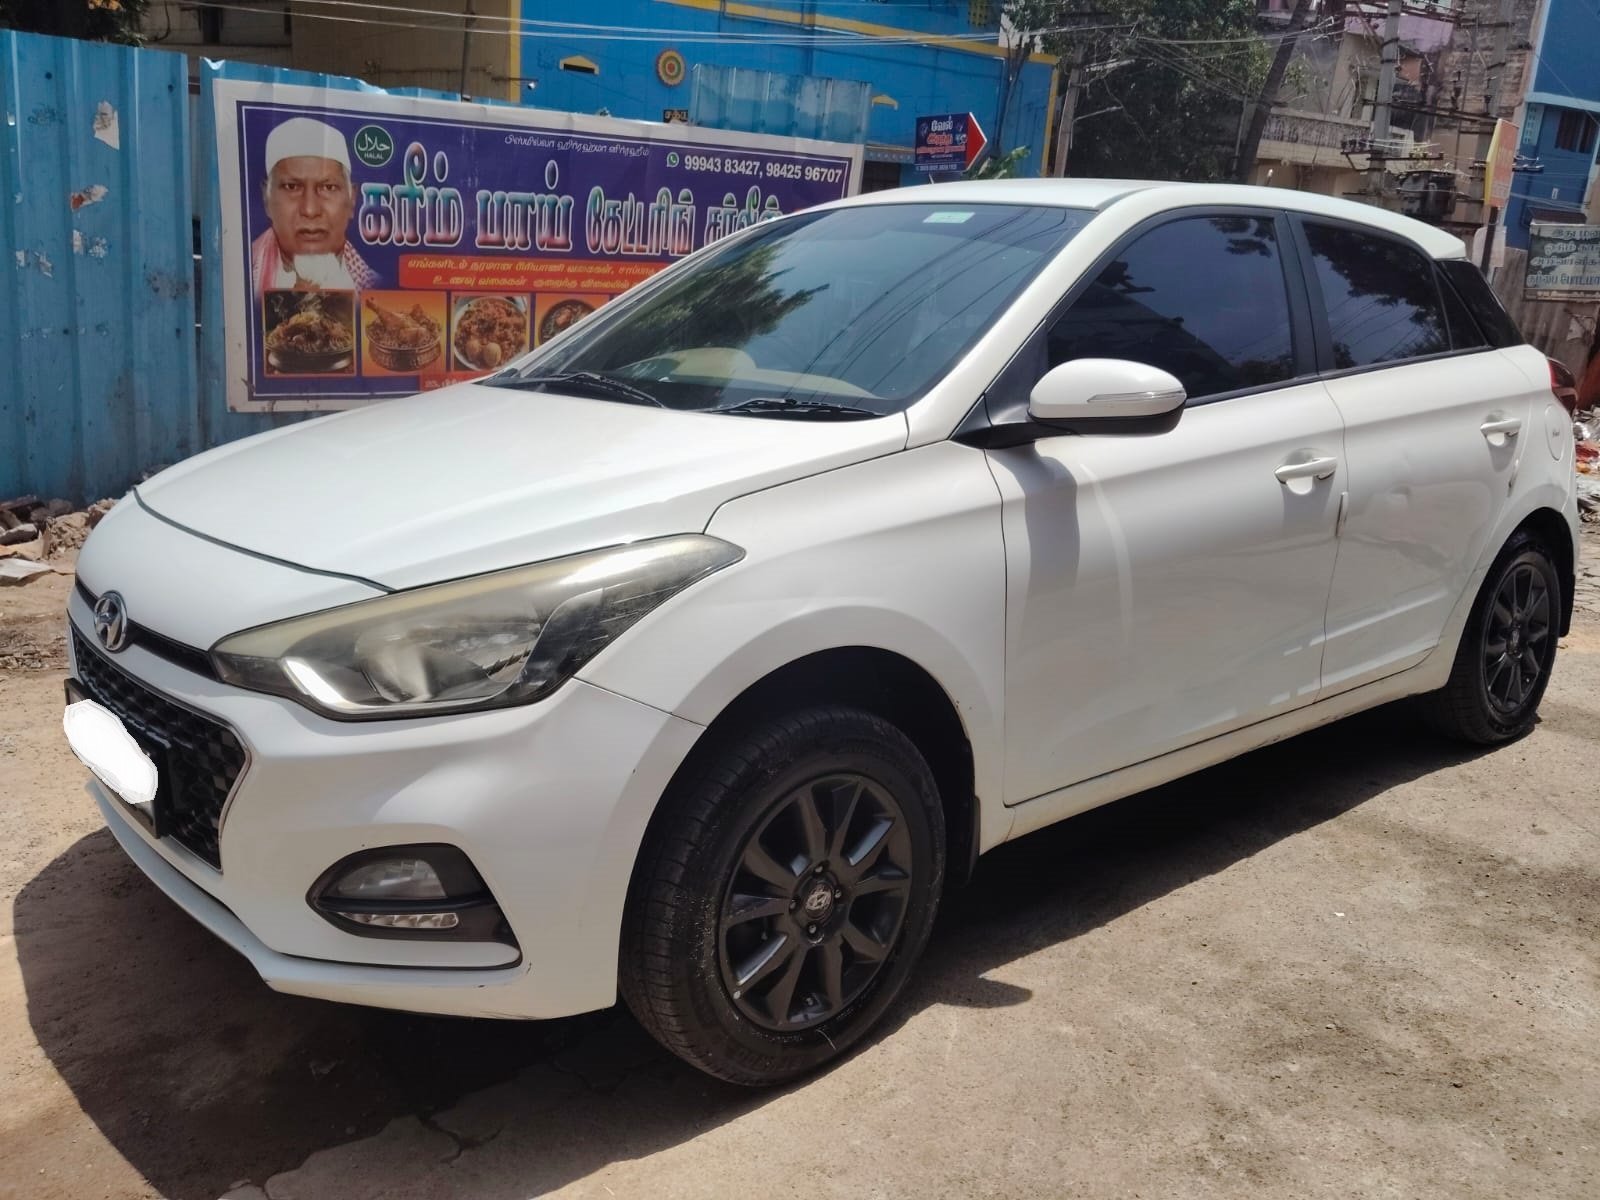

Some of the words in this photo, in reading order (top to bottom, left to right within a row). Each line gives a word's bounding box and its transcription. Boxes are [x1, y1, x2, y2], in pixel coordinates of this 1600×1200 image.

[358, 132, 390, 151] حلال
[364, 151, 384, 160] HALAL
[684, 155, 721, 173] 99943
[724, 159, 763, 179] 83427,
[766, 162, 801, 179] 98425
[804, 166, 842, 184] 96707
[359, 142, 464, 247] கரீம்
[475, 160, 574, 251] பாய்
[586, 186, 696, 257] கேட்டரிங்
